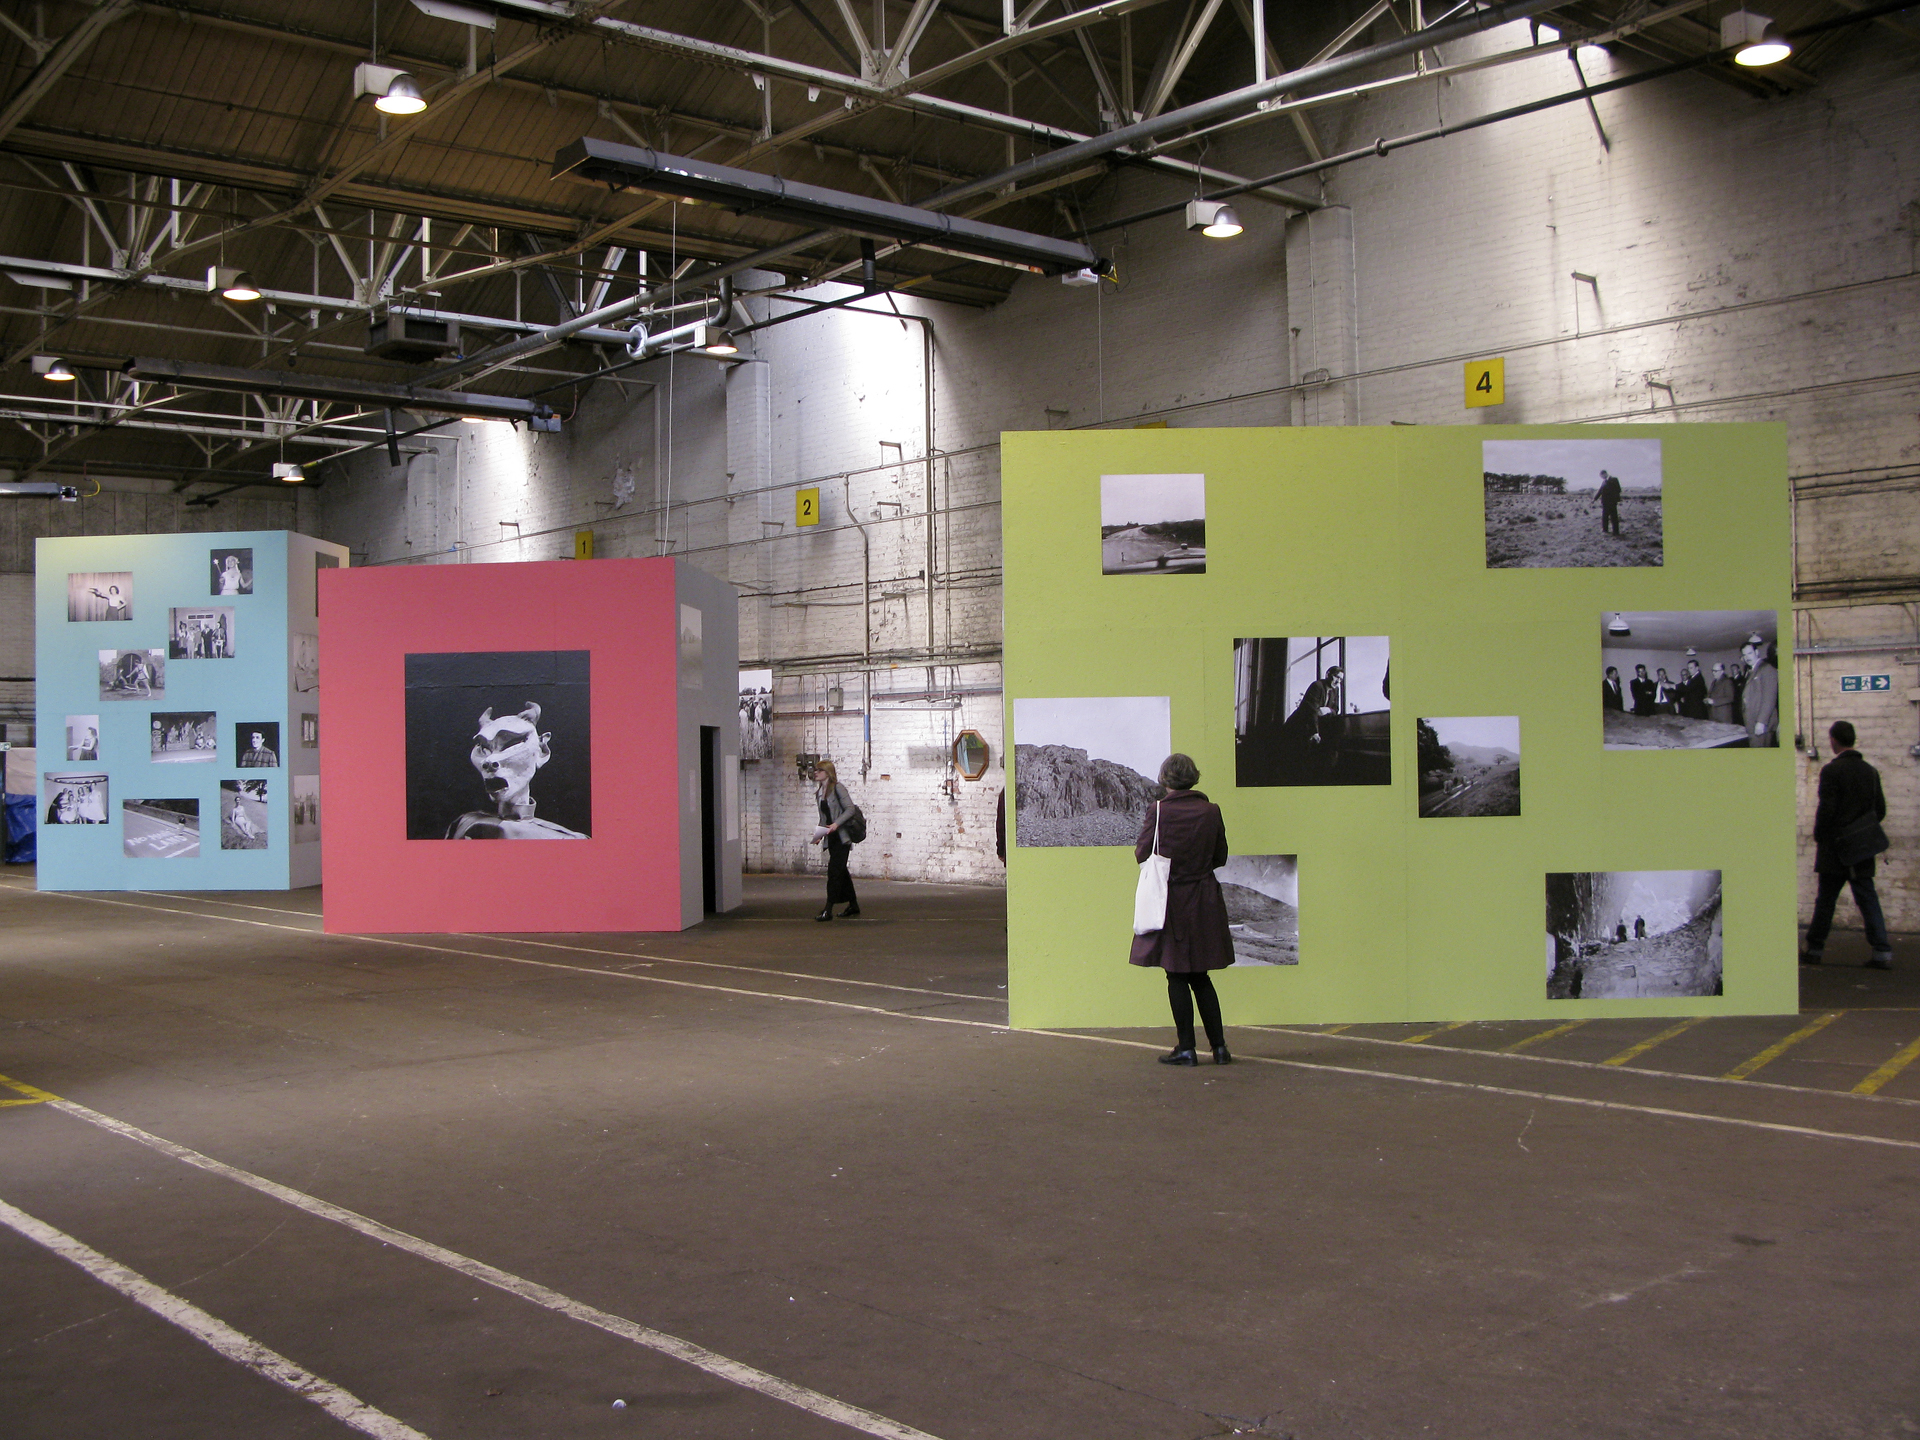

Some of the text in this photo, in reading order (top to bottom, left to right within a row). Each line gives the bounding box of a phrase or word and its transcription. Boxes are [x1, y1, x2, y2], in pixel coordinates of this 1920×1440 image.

[1476, 371, 1492, 393] 4
[803, 499, 811, 515] 2
[582, 540, 586, 554] 1
